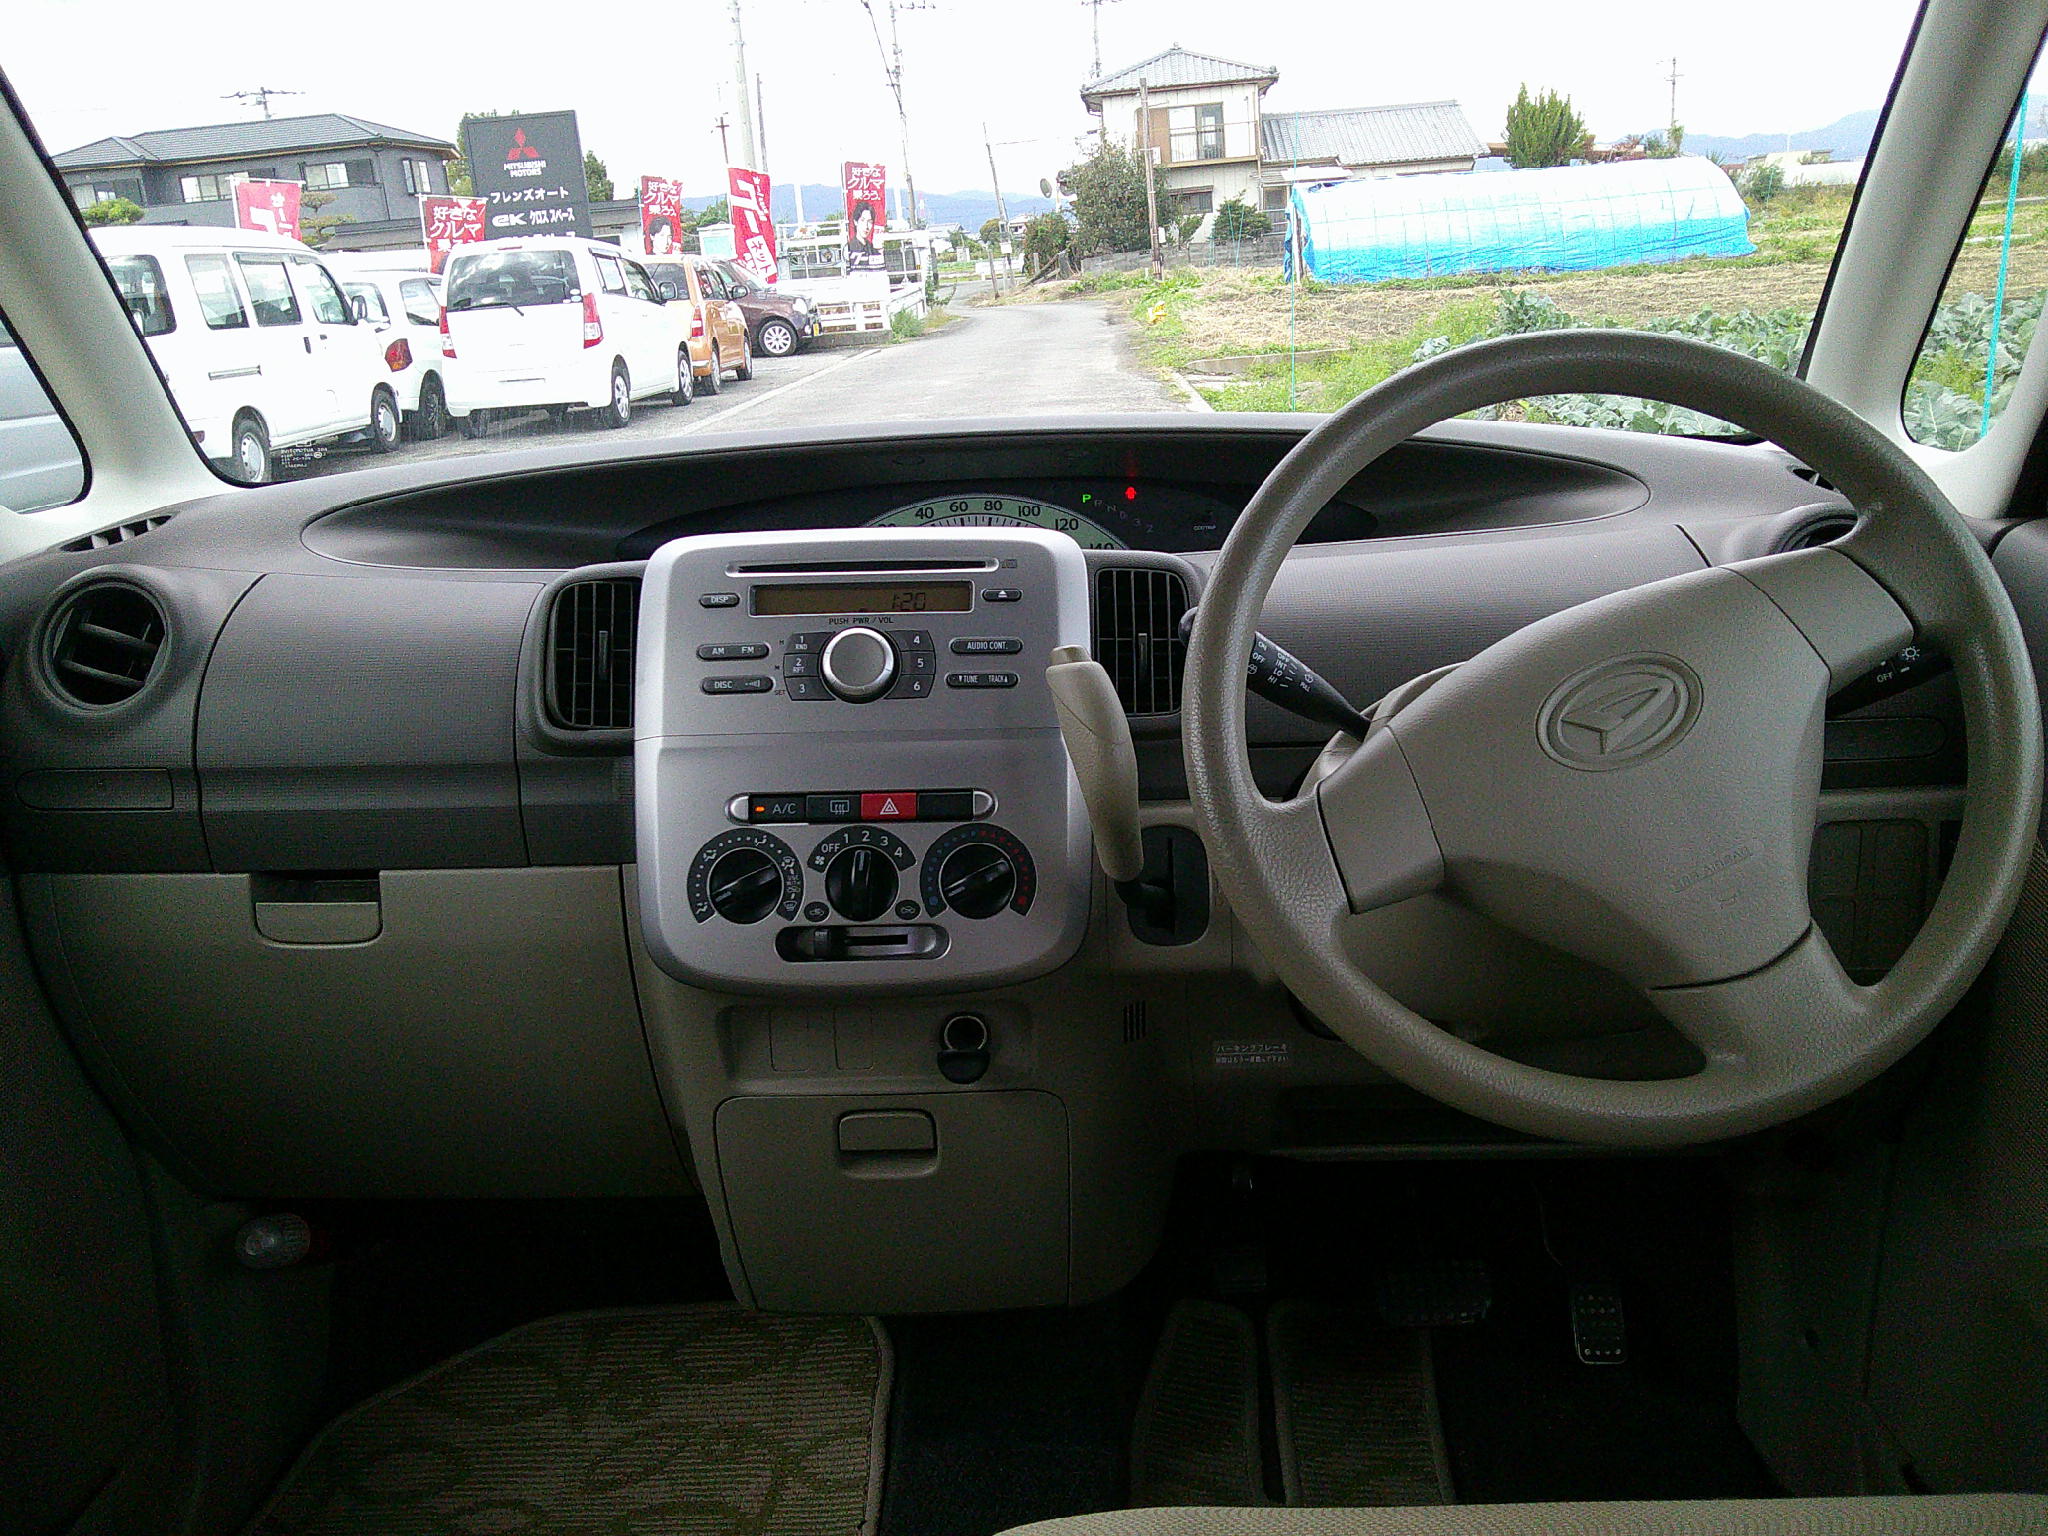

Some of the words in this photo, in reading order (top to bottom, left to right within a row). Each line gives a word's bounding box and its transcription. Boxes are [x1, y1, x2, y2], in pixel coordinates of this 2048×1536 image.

[503, 160, 546, 171] MITSUBISHI
[510, 168, 542, 178] MOTORS
[847, 176, 885, 189] クルマ
[490, 187, 569, 204] フレンズオート
[433, 206, 478, 221] 好きな
[430, 220, 482, 238] クルマ
[1082, 494, 1092, 503] P
[915, 506, 935, 520] 40
[949, 501, 969, 513] 60
[983, 500, 1003, 512] 80
[1018, 505, 1041, 517] 100
[1054, 517, 1079, 531] 120
[711, 595, 729, 604] DISP
[892, 592, 926, 611] 1:20
[828, 617, 849, 625] PUSH
[852, 616, 870, 624] PWR
[878, 615, 894, 624] VOL
[800, 635, 805, 644] 1
[913, 635, 921, 645] 4
[967, 641, 988, 650] AUDIO
[711, 648, 725, 656] AM
[741, 646, 755, 655] FM
[796, 657, 802, 667] 2
[1252, 652, 1265, 663] OFF
[917, 658, 924, 668] 5
[1275, 659, 1288, 670] INT
[1272, 668, 1283, 677] LO
[964, 675, 978, 684] TUNE
[988, 674, 1004, 683] TRACK
[714, 680, 733, 689] DISC
[799, 683, 806, 694] 3
[913, 681, 921, 691] 6
[772, 803, 797, 814] A/C
[821, 843, 841, 854] OFF
[844, 833, 849, 844] 1
[861, 831, 871, 842] 2
[880, 836, 889, 846] 3
[894, 847, 903, 858] 4
